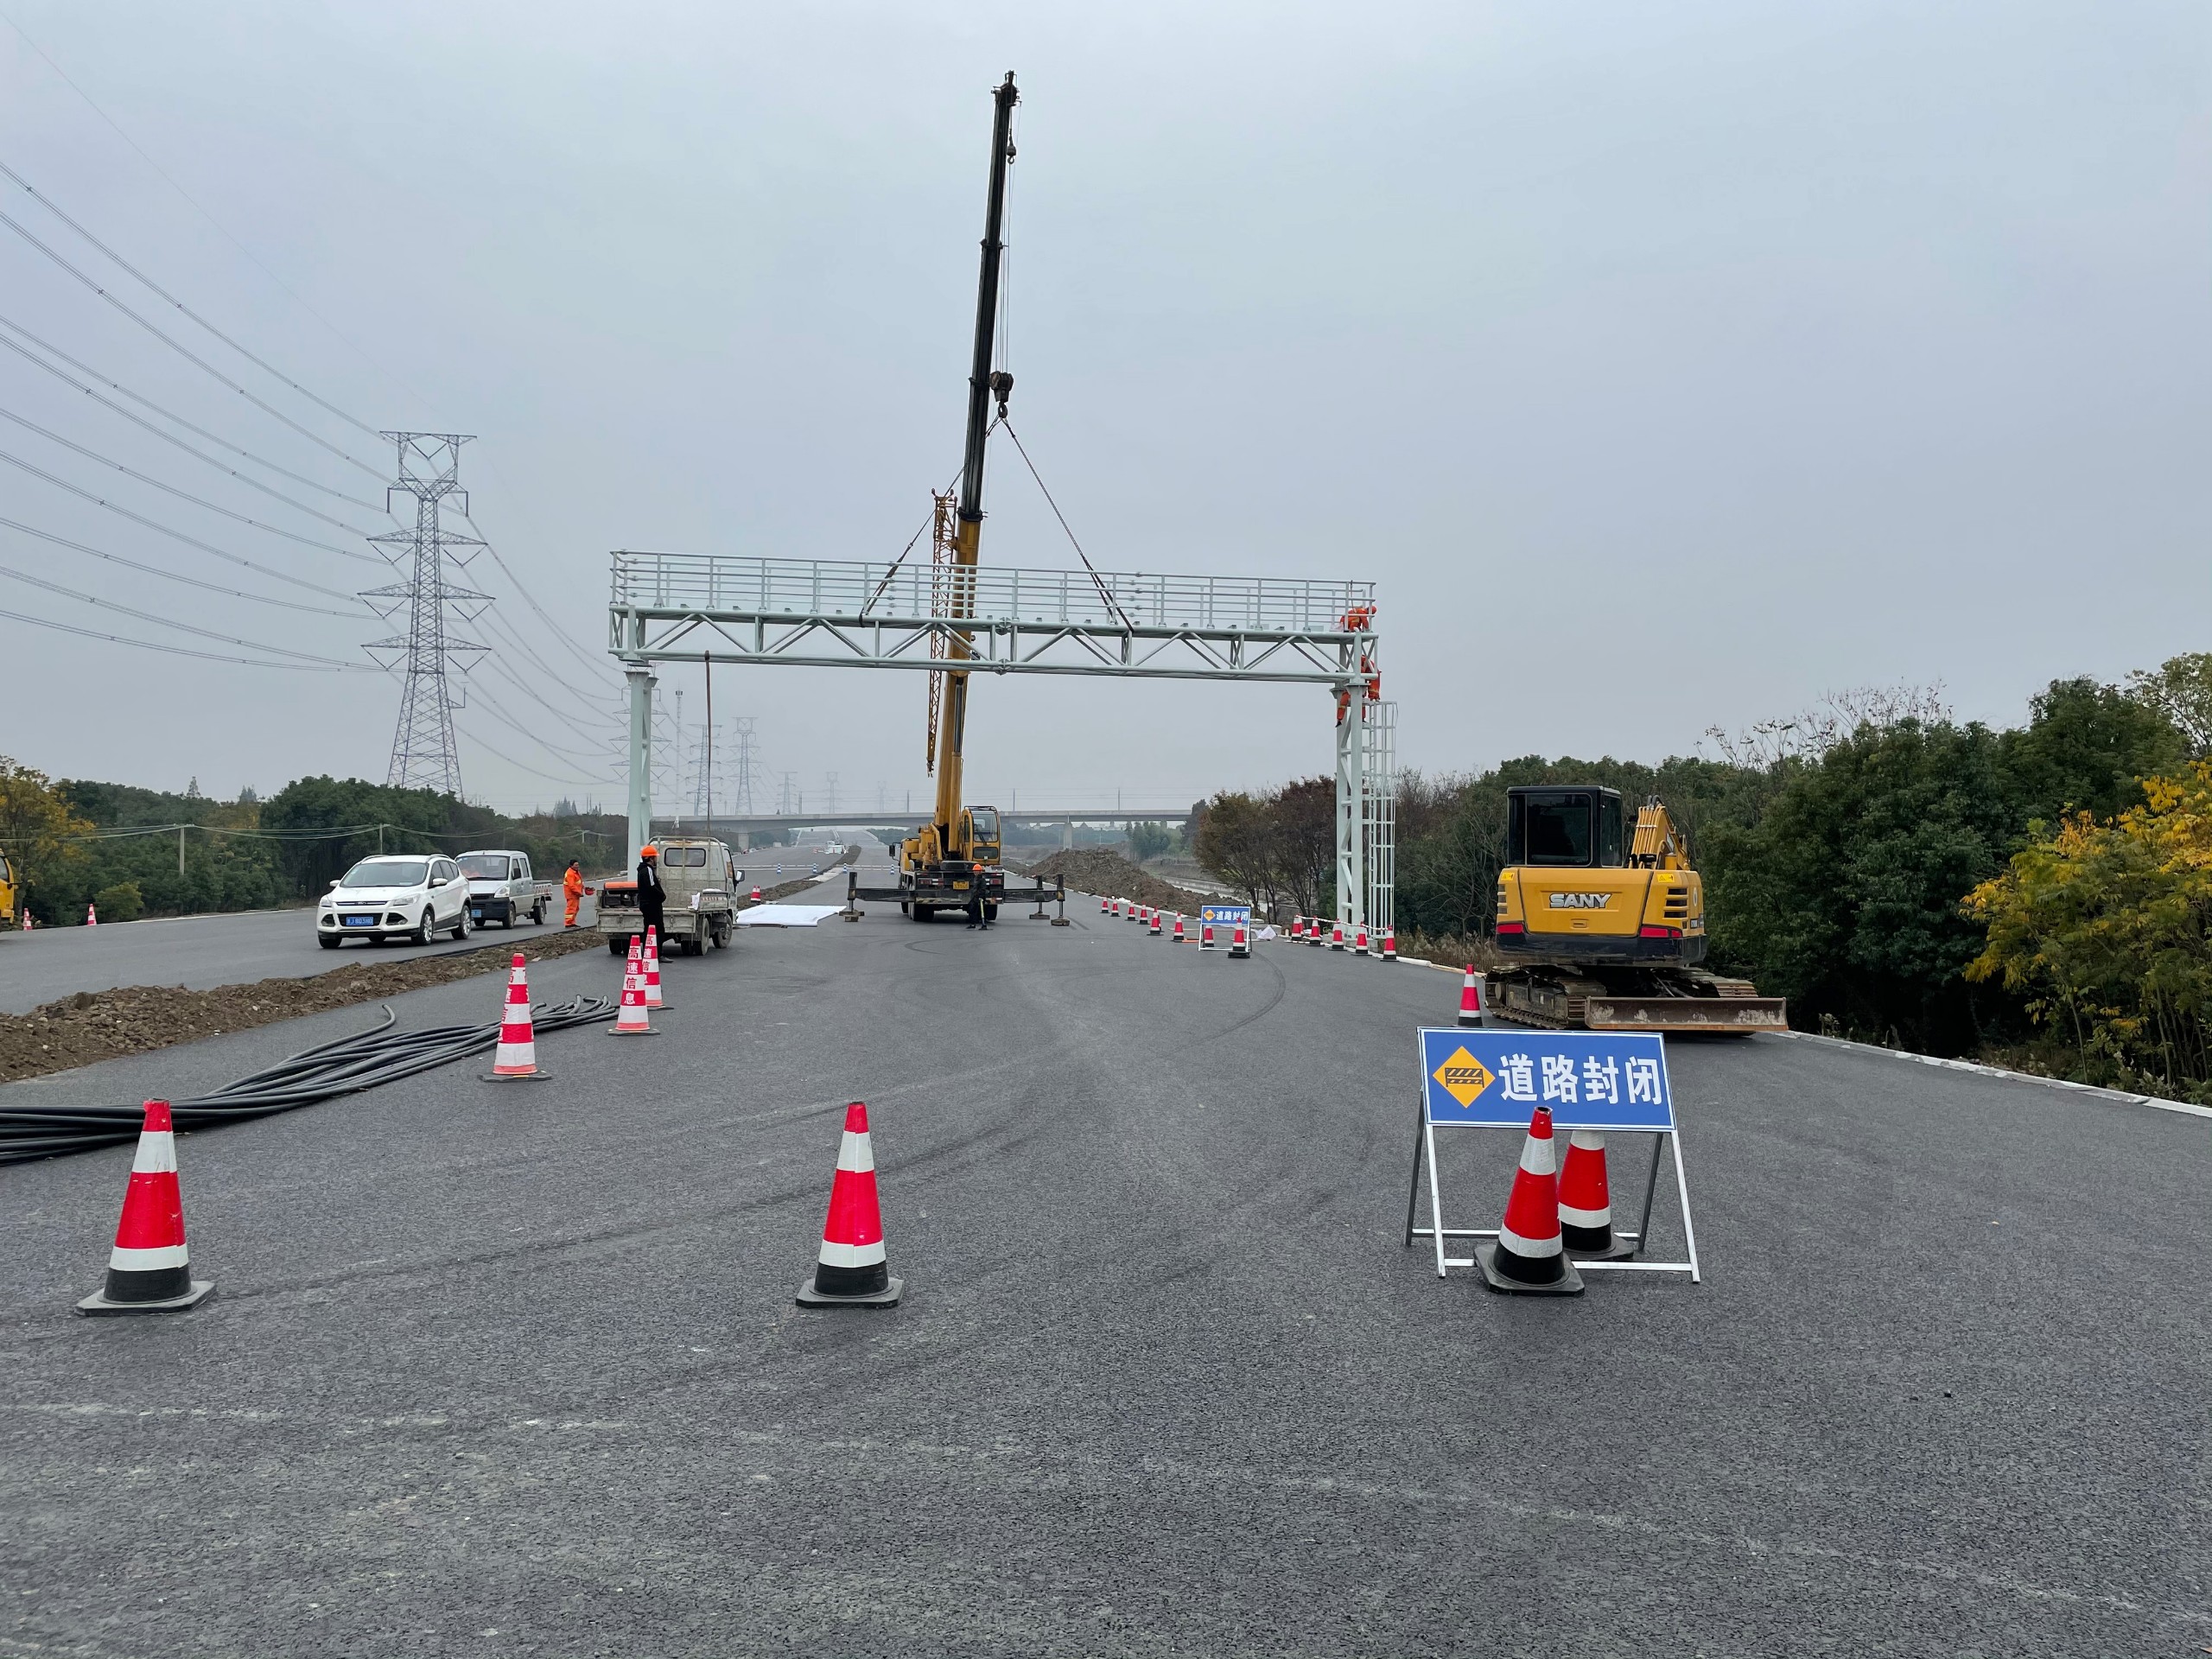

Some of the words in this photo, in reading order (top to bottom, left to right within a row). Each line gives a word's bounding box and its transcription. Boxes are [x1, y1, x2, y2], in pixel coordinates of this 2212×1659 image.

[1216, 911, 1249, 921] 道路封闭
[1549, 893, 1611, 908] SANY
[624, 947, 639, 1004] 高速信息
[1497, 1053, 1662, 1105] 道路封闭
